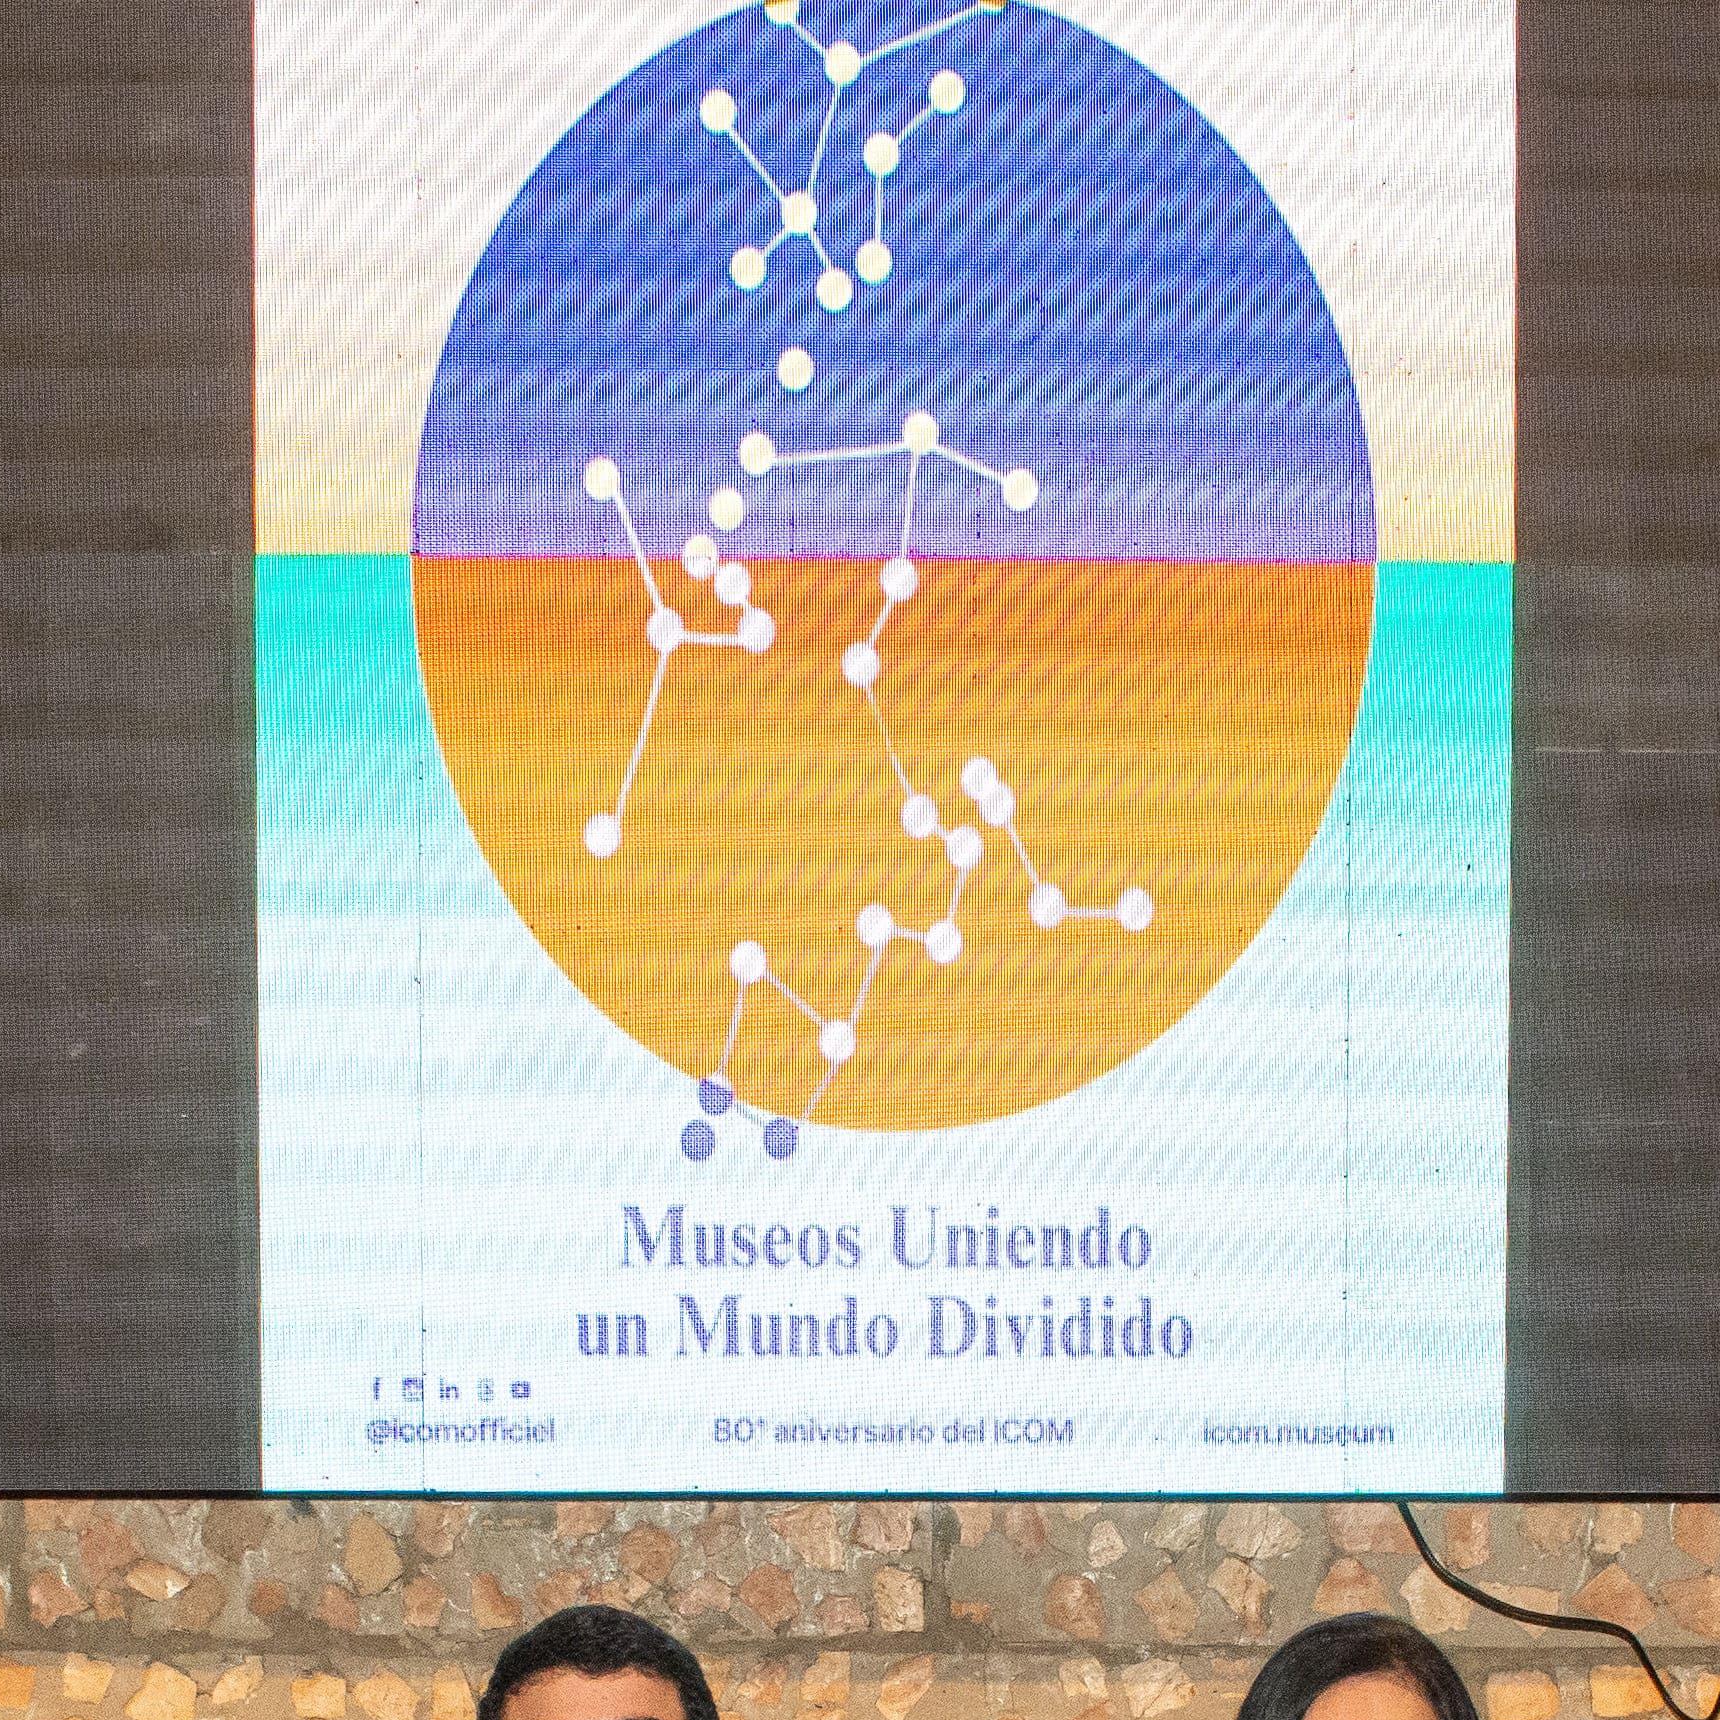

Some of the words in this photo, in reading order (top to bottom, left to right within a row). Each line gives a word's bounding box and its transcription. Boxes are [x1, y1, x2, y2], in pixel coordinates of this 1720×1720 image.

[621, 1202, 863, 1269] Museos
[891, 1204, 1153, 1269] Uniendo
[576, 1313, 648, 1357] un
[675, 1294, 899, 1358] Mundo
[928, 1295, 1195, 1358] Dividido
[774, 1418, 936, 1443] aniversario
[942, 1418, 986, 1443] del
[993, 1418, 1075, 1443] ICOM
[1203, 1417, 1396, 1445] icom.museum
